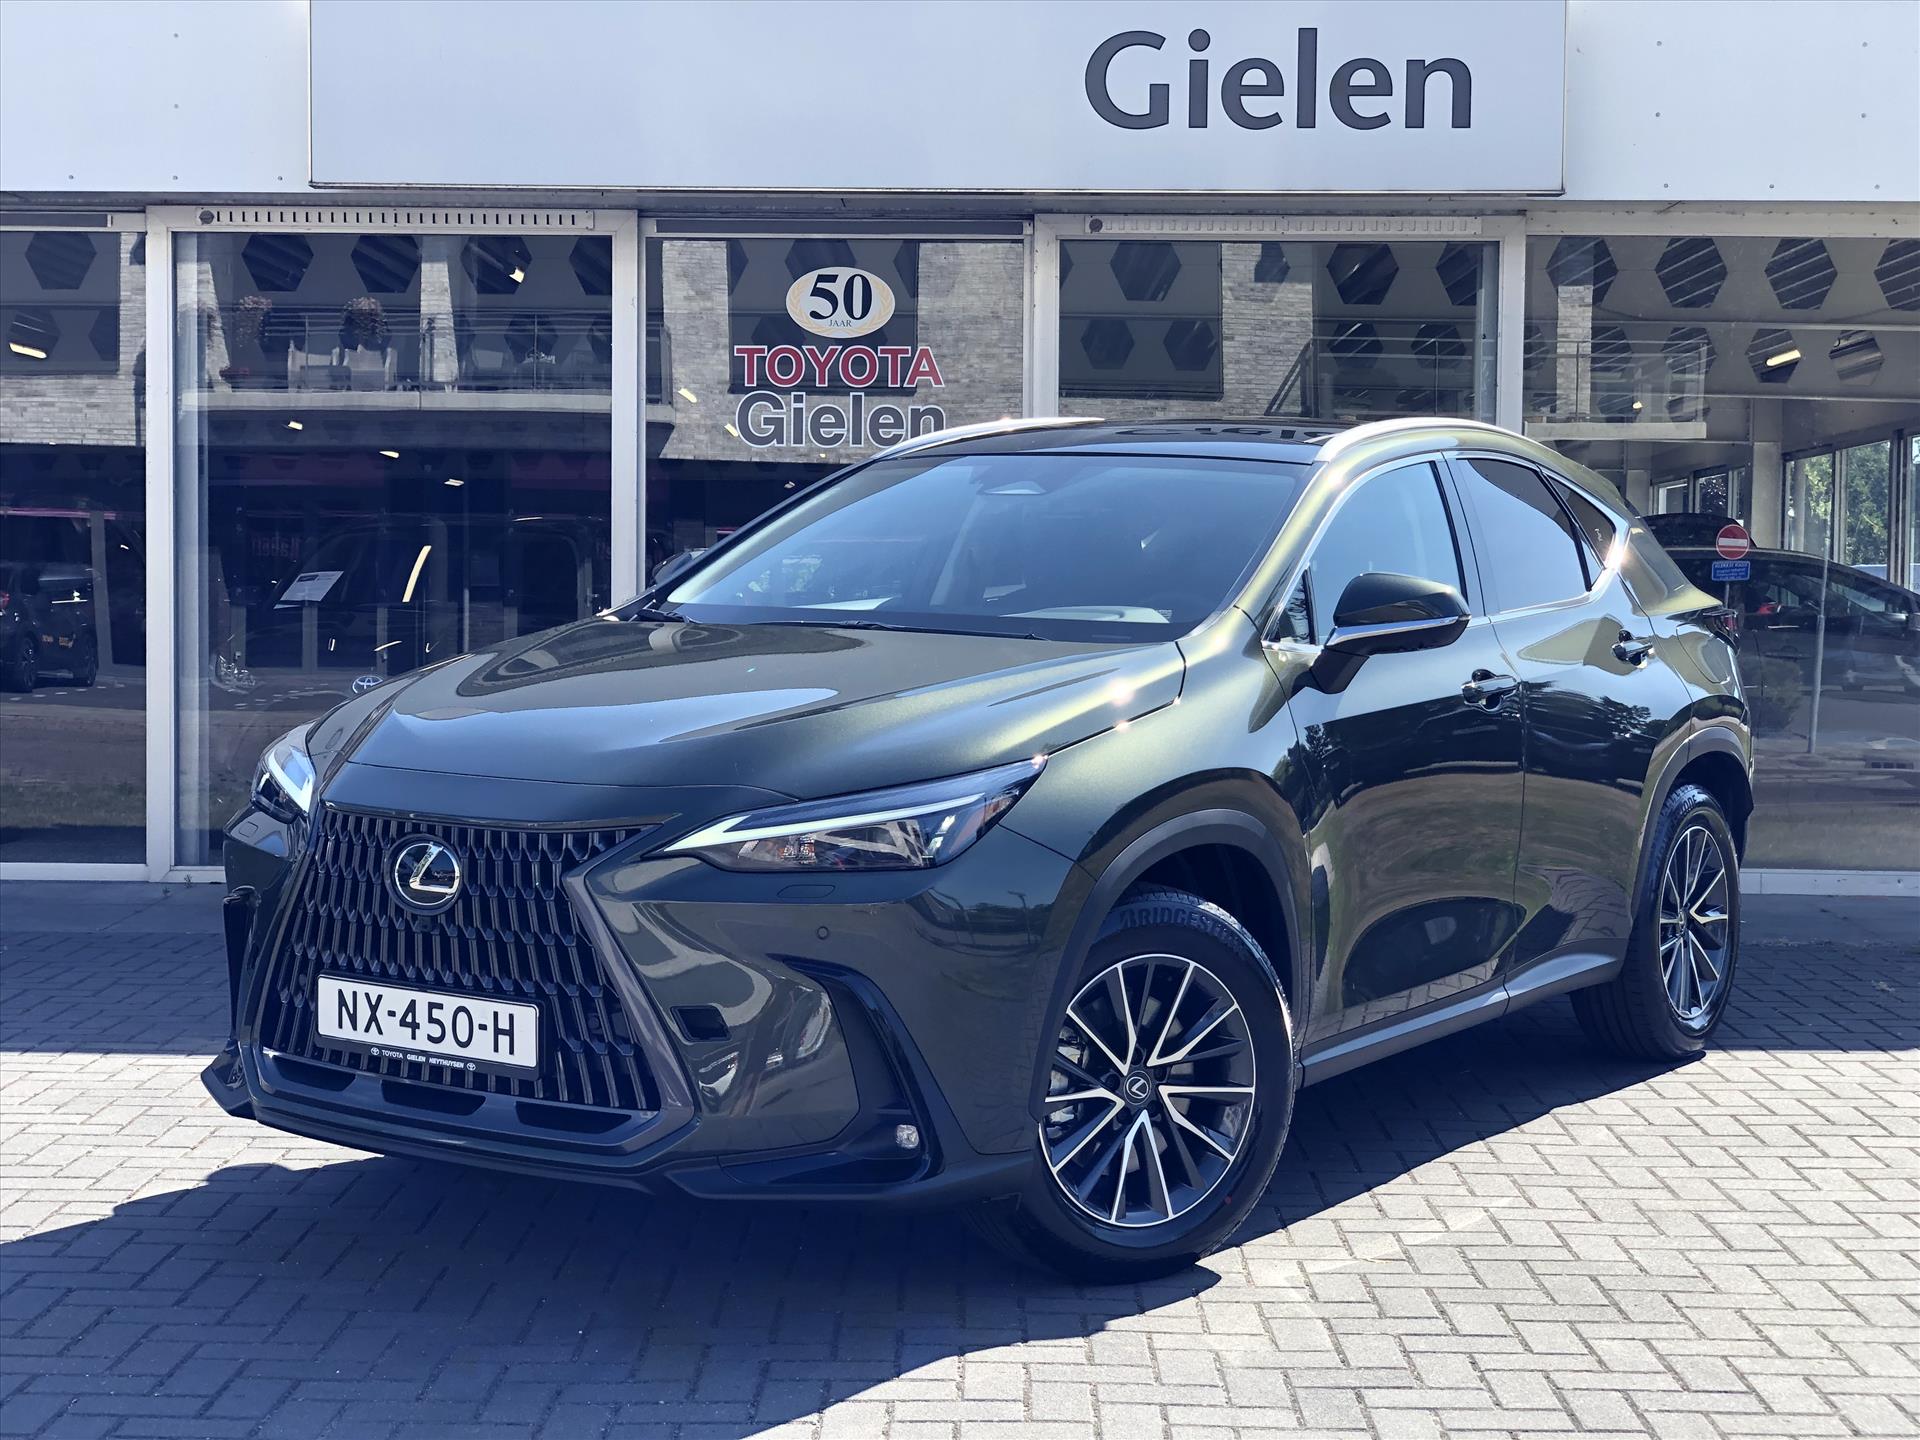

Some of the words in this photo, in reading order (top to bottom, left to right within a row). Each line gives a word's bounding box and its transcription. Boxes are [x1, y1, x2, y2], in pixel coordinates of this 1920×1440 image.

[1085, 28, 1472, 130] Gielen
[809, 273, 873, 320] 50
[829, 319, 852, 328] JAAR
[734, 344, 945, 388] TOYOTA
[735, 390, 946, 448] Gielen
[337, 988, 515, 1055] NX-450-H
[382, 1049, 404, 1059] TOYOTA
[406, 1053, 426, 1062] GIELEN
